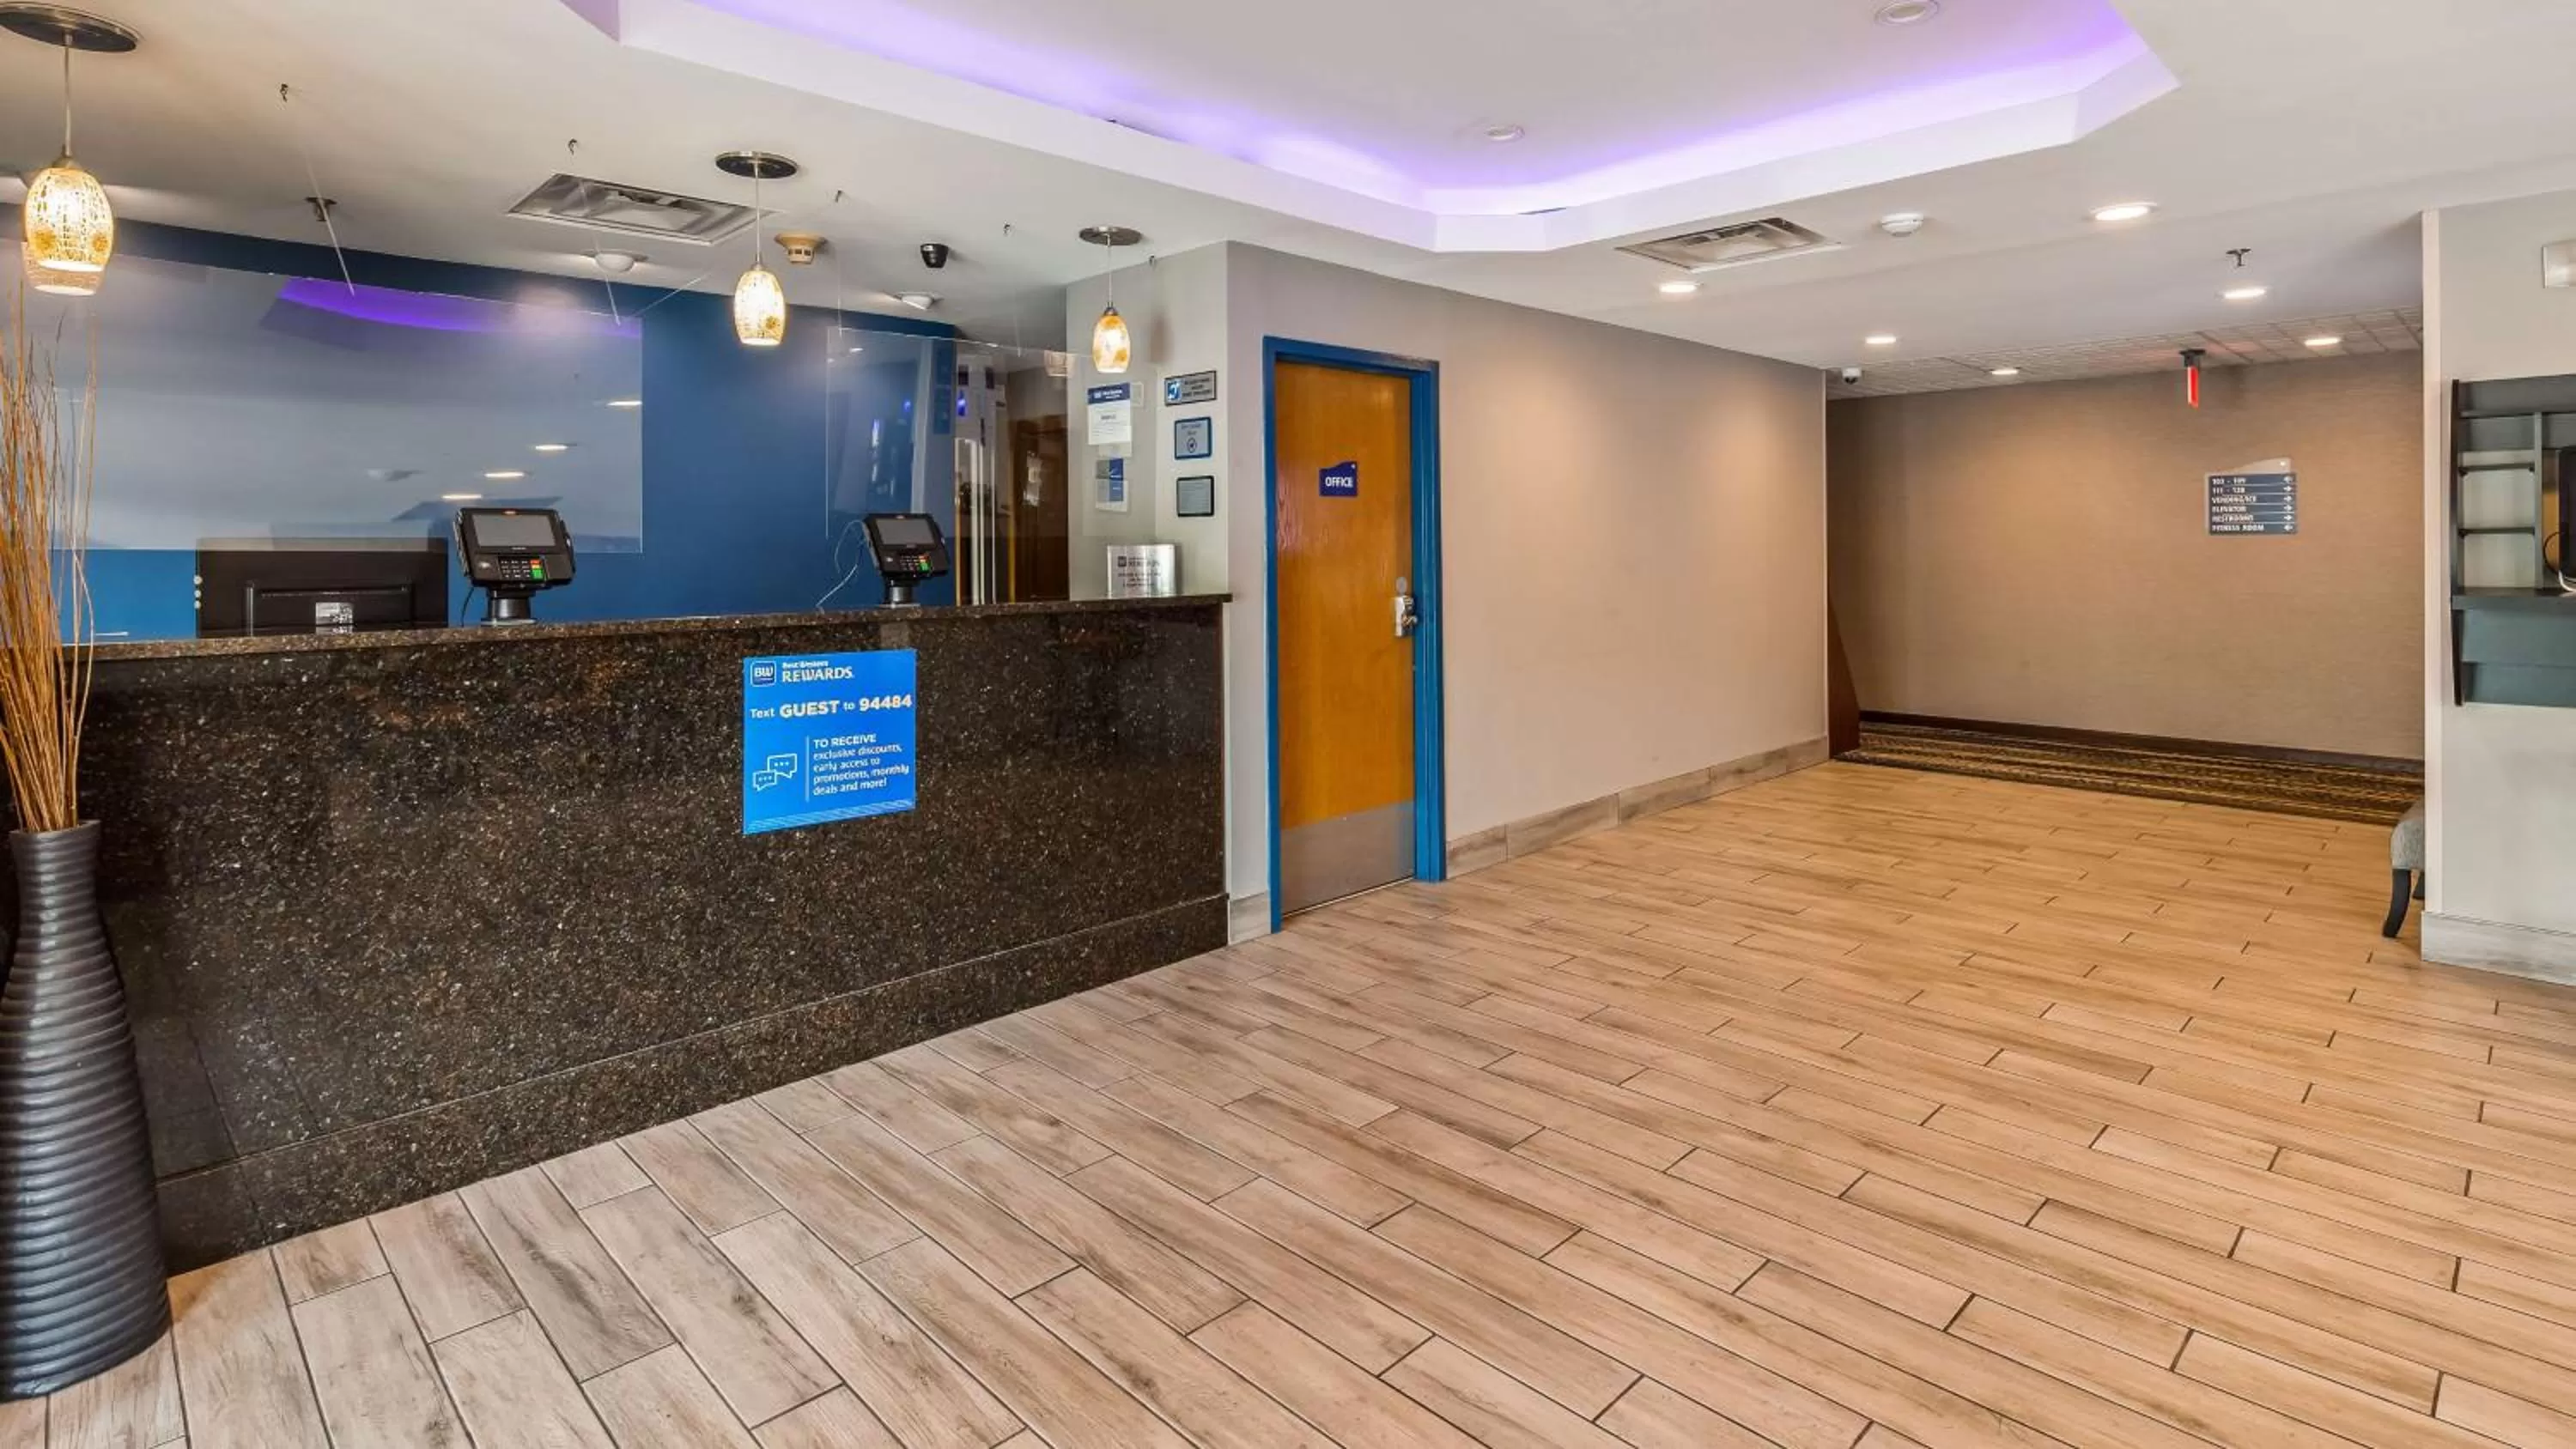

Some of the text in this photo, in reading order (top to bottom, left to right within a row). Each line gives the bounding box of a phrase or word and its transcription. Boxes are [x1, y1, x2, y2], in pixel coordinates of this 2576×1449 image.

[1325, 476, 1354, 488] OFFICE
[754, 665, 774, 677] BW
[782, 666, 854, 683] REWARDS
[750, 694, 913, 718] Text GUEST to 94484
[813, 733, 877, 749] TO RECEIVE
[813, 749, 856, 761] exclusive
[813, 756, 880, 773] early access to
[813, 763, 909, 785] promotions, monthly
[813, 776, 887, 796] deals and more!
